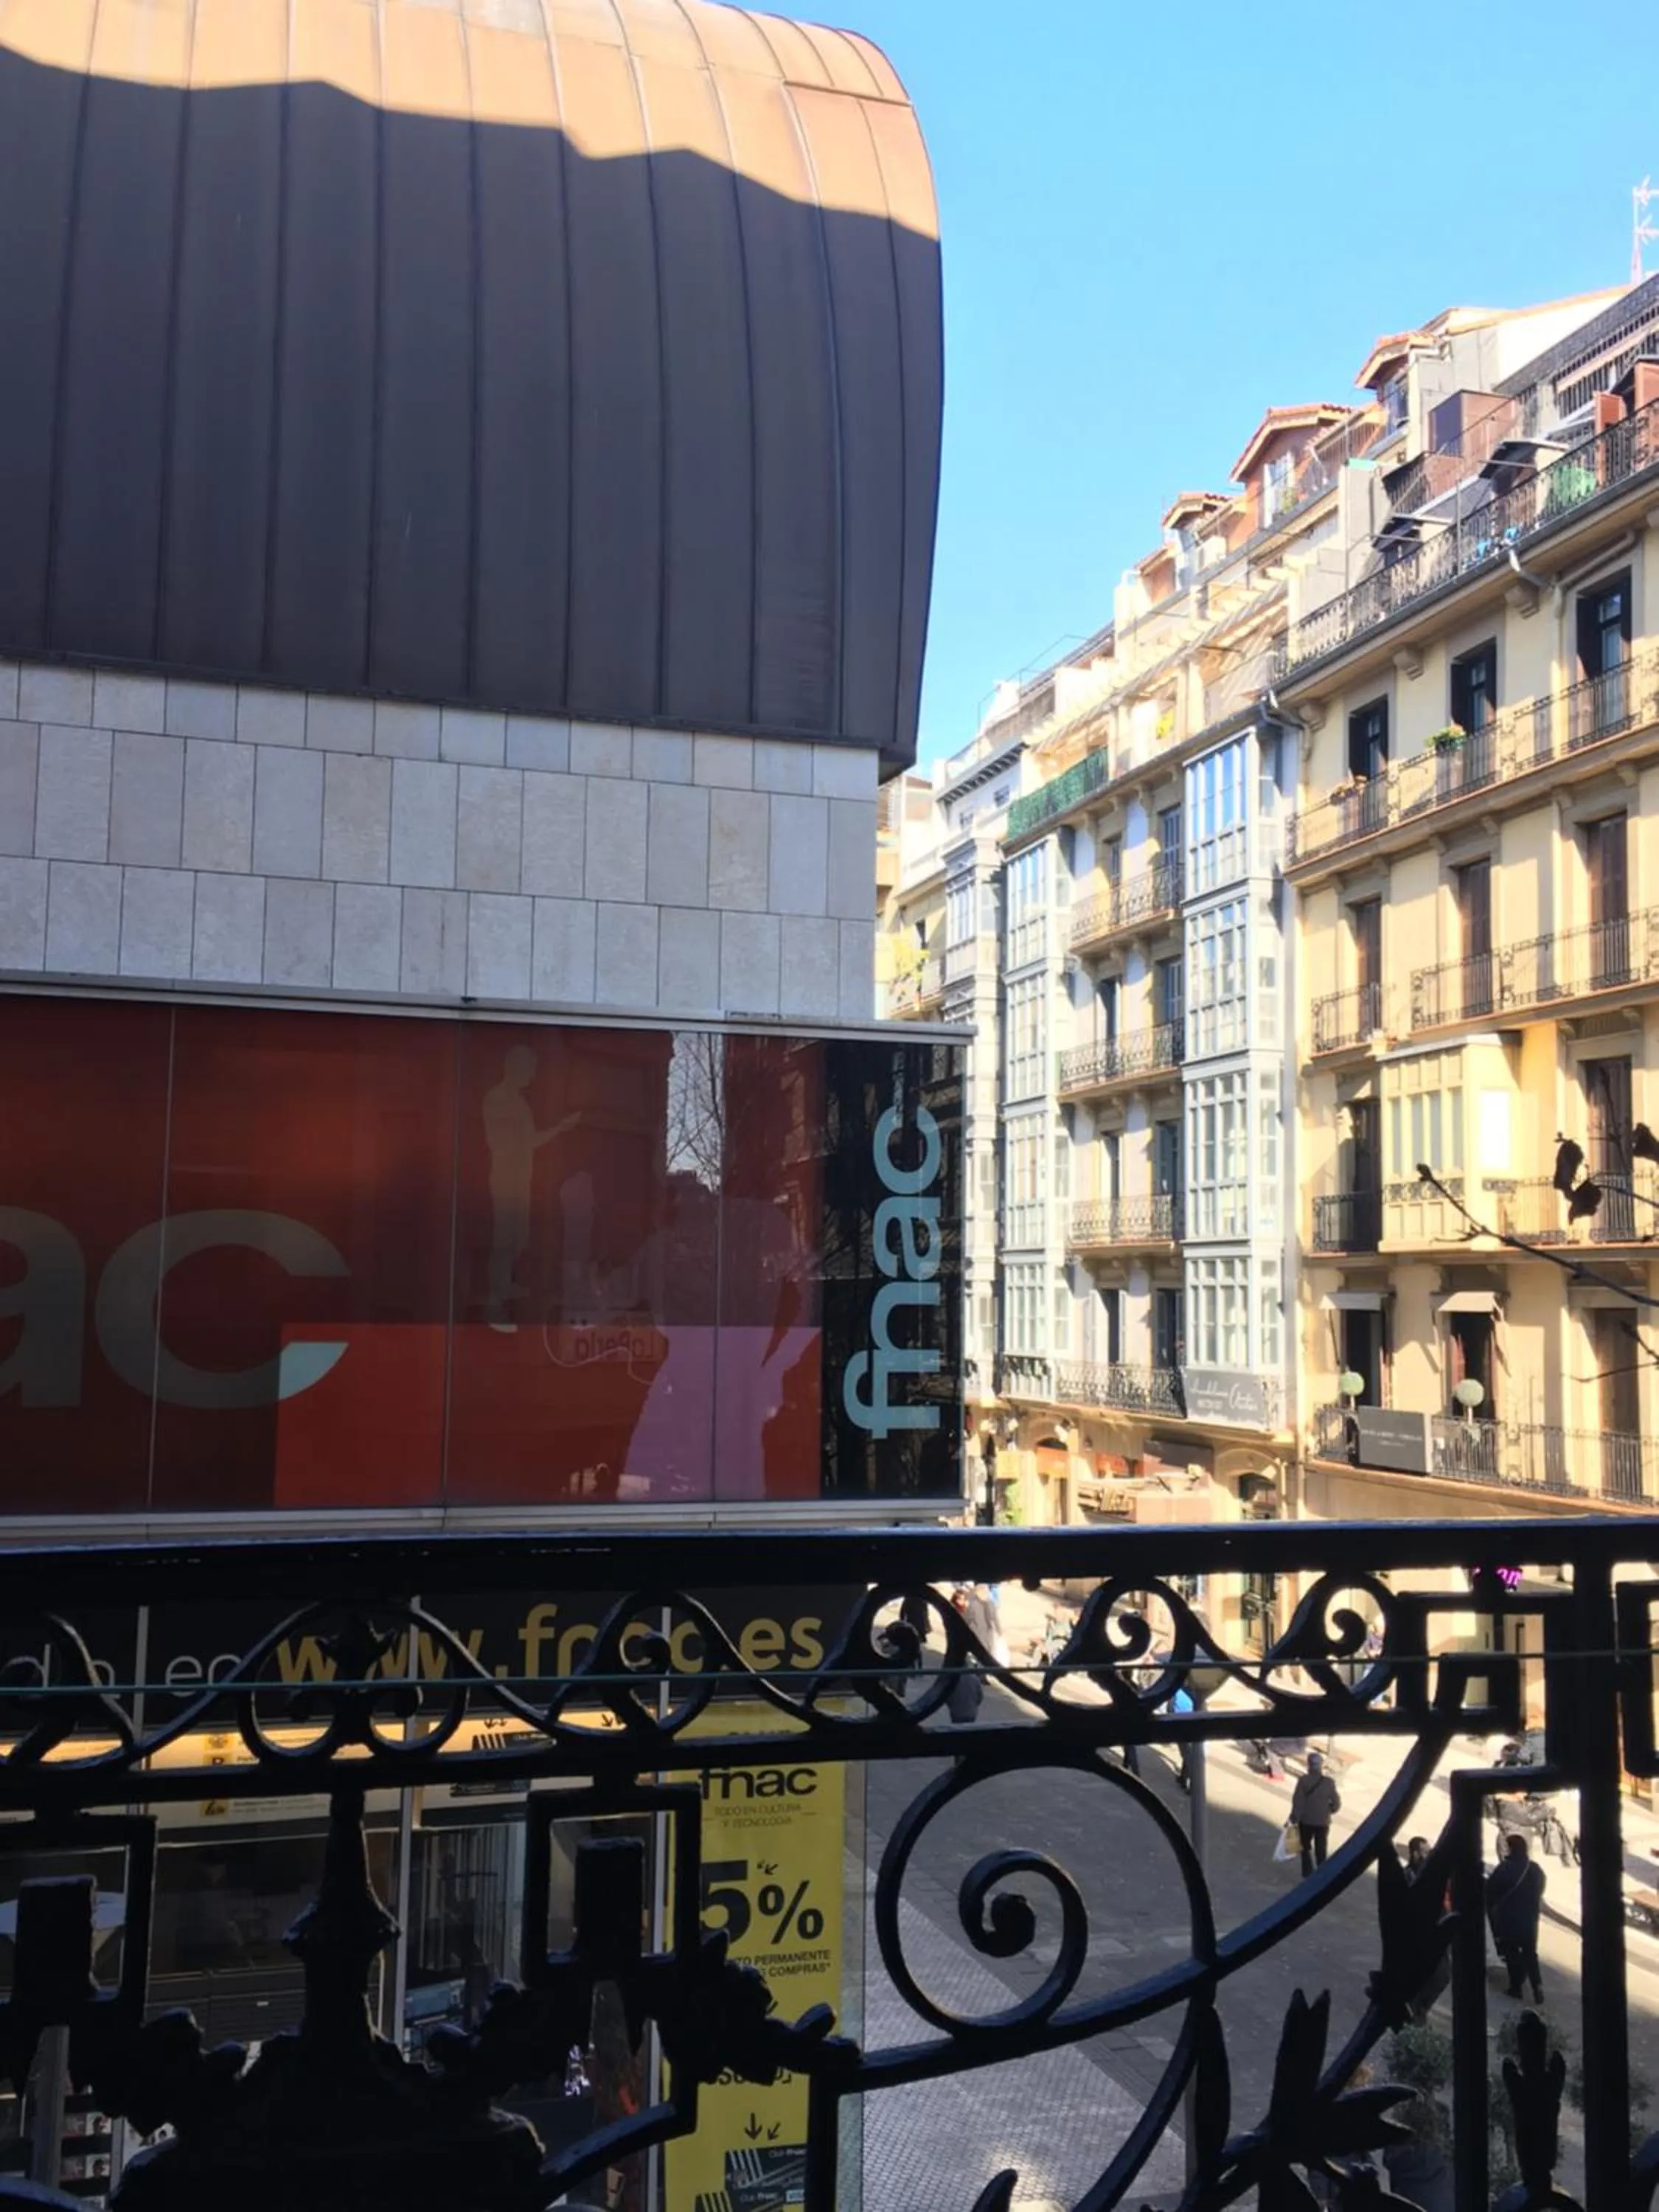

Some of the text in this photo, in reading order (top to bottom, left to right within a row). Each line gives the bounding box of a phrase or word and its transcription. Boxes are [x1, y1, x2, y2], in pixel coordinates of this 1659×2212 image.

[843, 1104, 942, 1439] fnac
[699, 1767, 817, 1799] fnac
[754, 1950, 830, 1966] PERMANENTE
